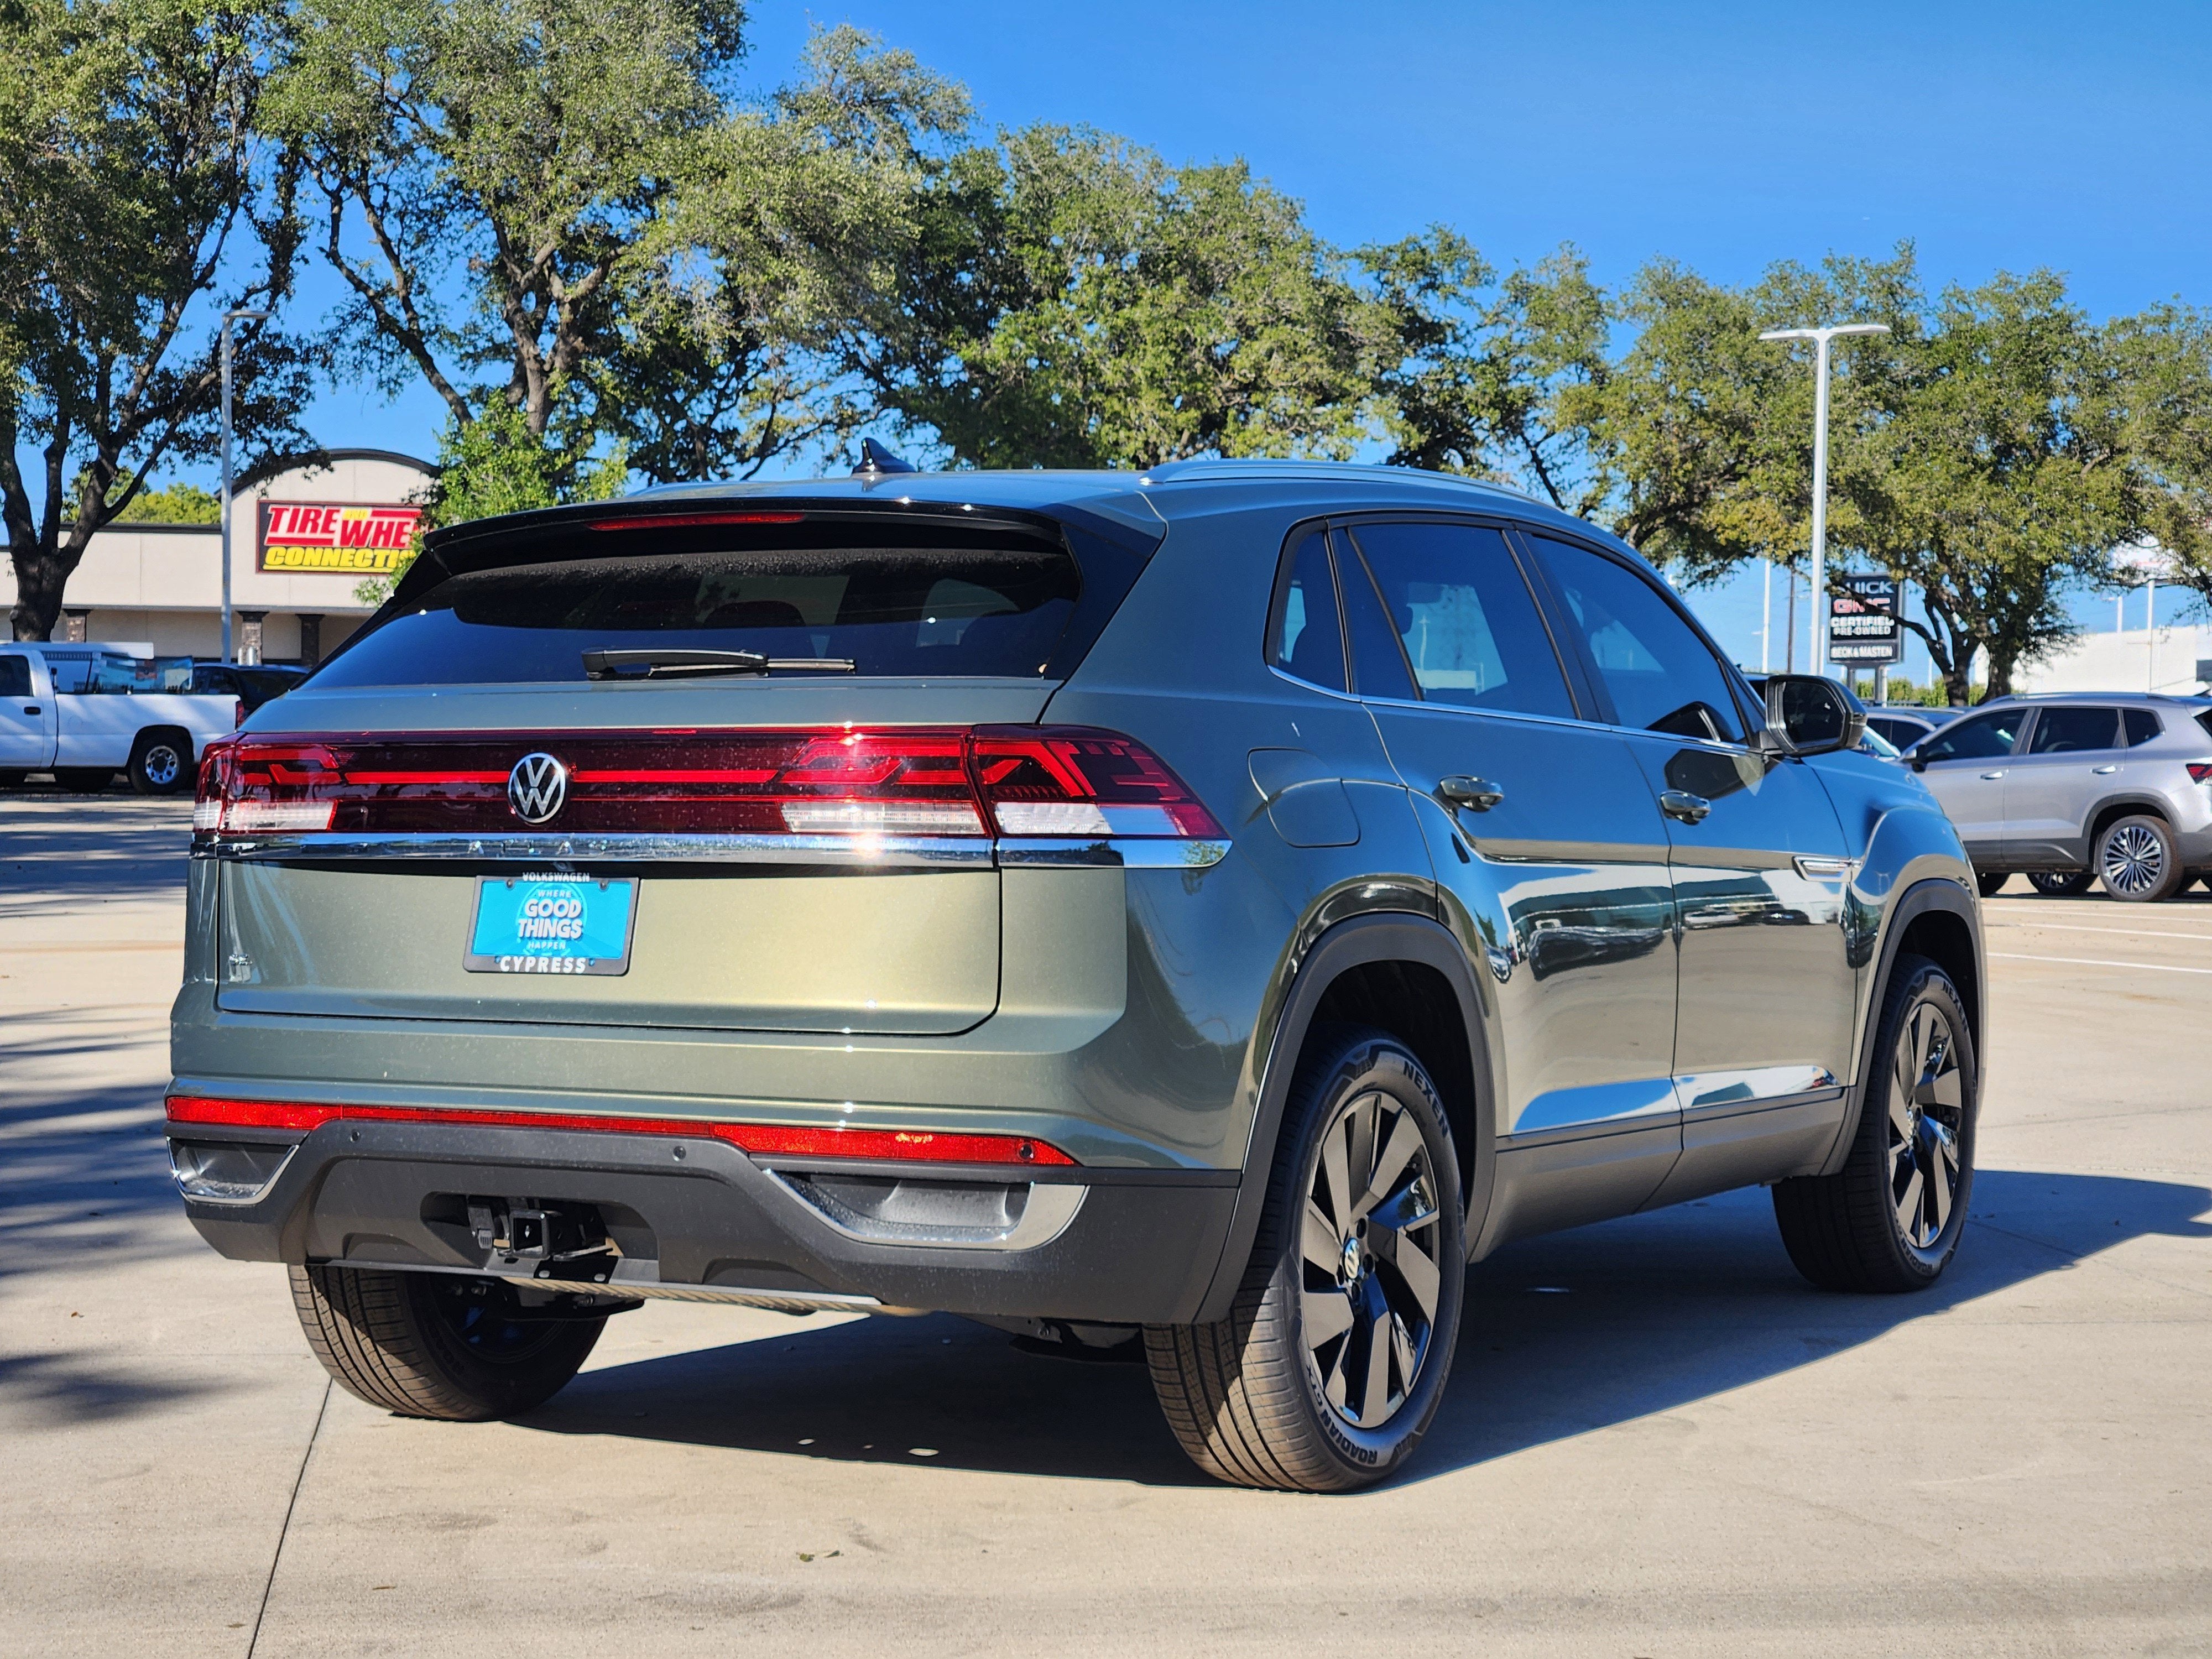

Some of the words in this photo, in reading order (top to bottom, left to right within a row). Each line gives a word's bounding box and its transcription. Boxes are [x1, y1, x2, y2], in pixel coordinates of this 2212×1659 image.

[269, 506, 341, 534] TIRE
[339, 520, 419, 548] WHE
[1833, 626, 1891, 635] PRE-OWNED
[522, 872, 590, 882] VOLKSWAGEN
[538, 889, 572, 898] WHERE
[525, 898, 582, 919] GOOD
[517, 917, 583, 939] THINGS
[528, 940, 566, 950] HAPPEN
[500, 956, 586, 974] CYPRESS
[1402, 1060, 1449, 1138] NEXEN
[1319, 1408, 1378, 1464] ROADIAN
